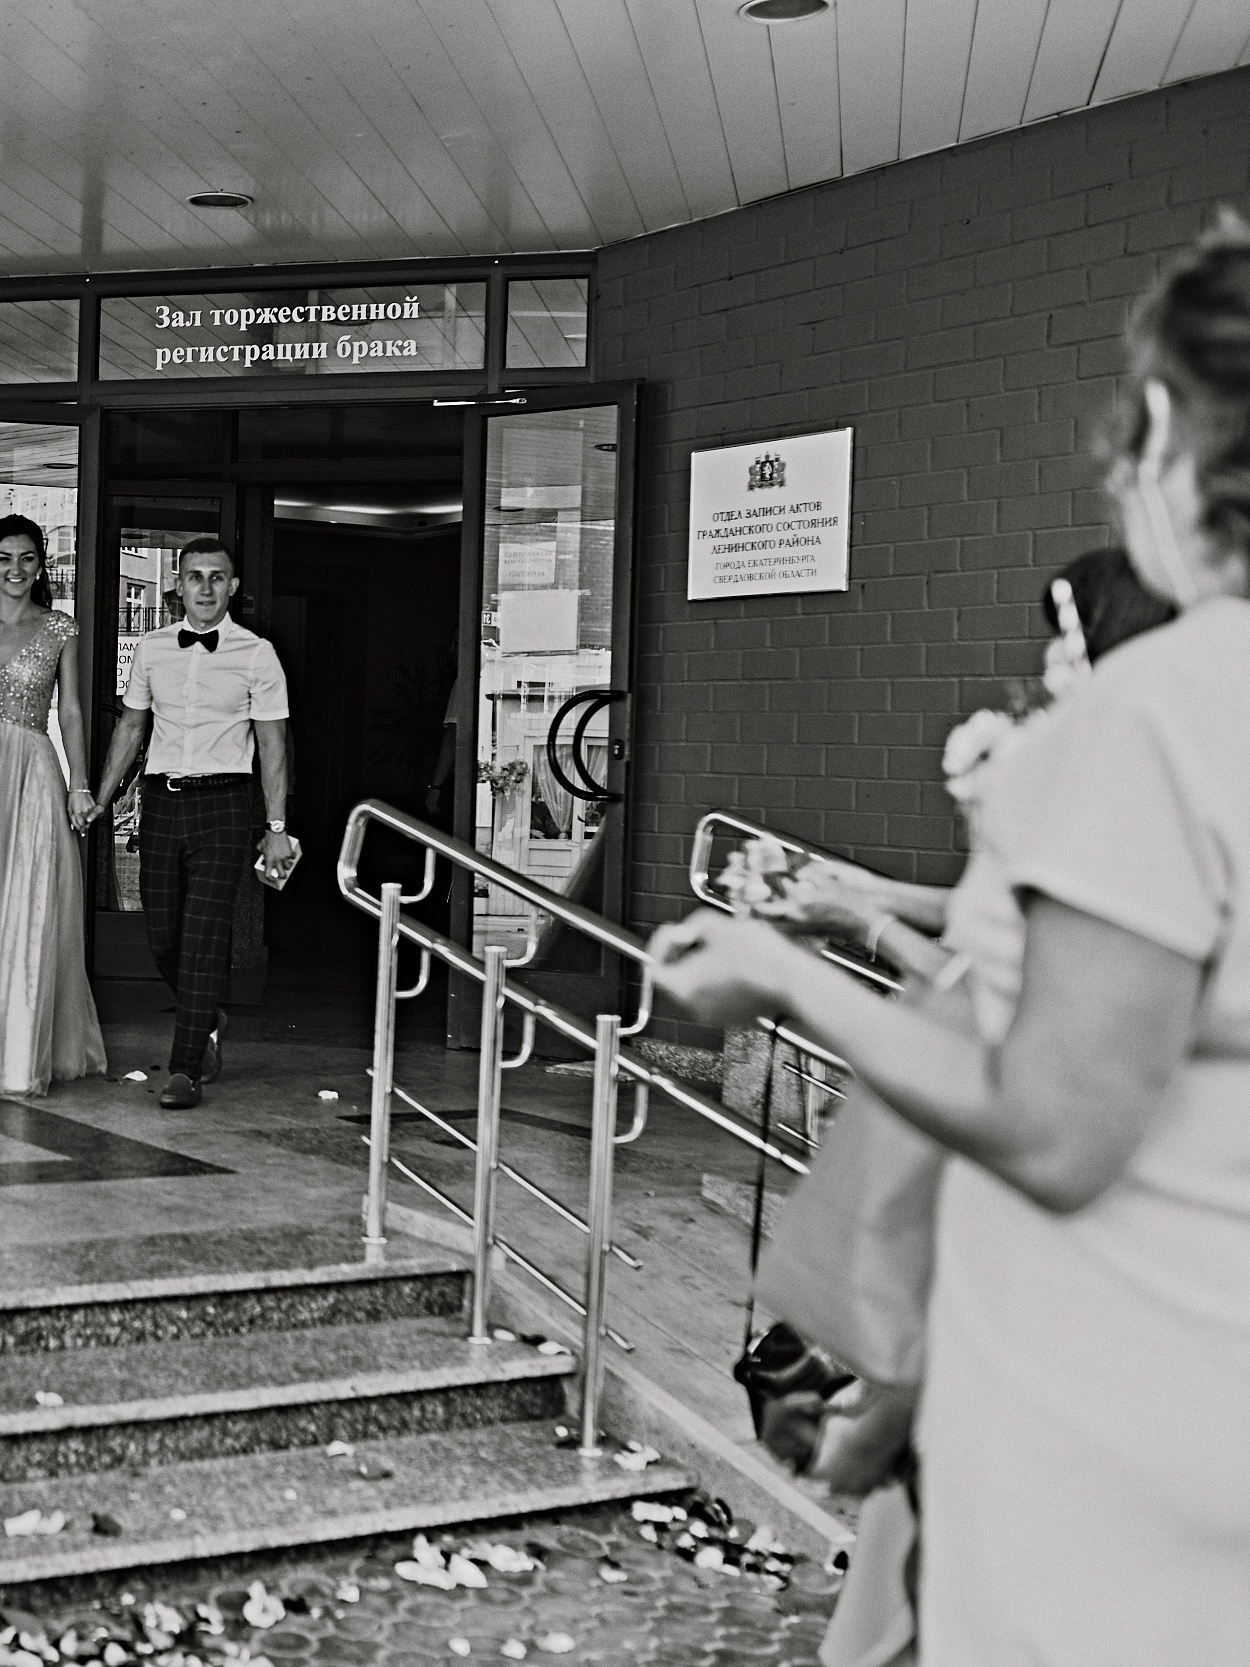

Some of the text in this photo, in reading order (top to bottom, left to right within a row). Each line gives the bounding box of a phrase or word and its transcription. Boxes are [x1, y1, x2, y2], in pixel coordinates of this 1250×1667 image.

[155, 296, 420, 332] Зал торжественной
[155, 335, 418, 370] регистрации брака
[712, 501, 823, 522] ОТДЕЛ ЗАПИСИ АКТОВ
[697, 516, 839, 540] ГРАЖДАНСКОГО СОСТОЯНИЯ
[711, 533, 822, 555] ЛЕНИНСКОГО РАЙОНА
[715, 554, 816, 571] ГОРОДА ЕКАТЕРИНБУРГА
[713, 568, 817, 584] СВЕРДЛОВСКОЙ ОБЛАСТИ
